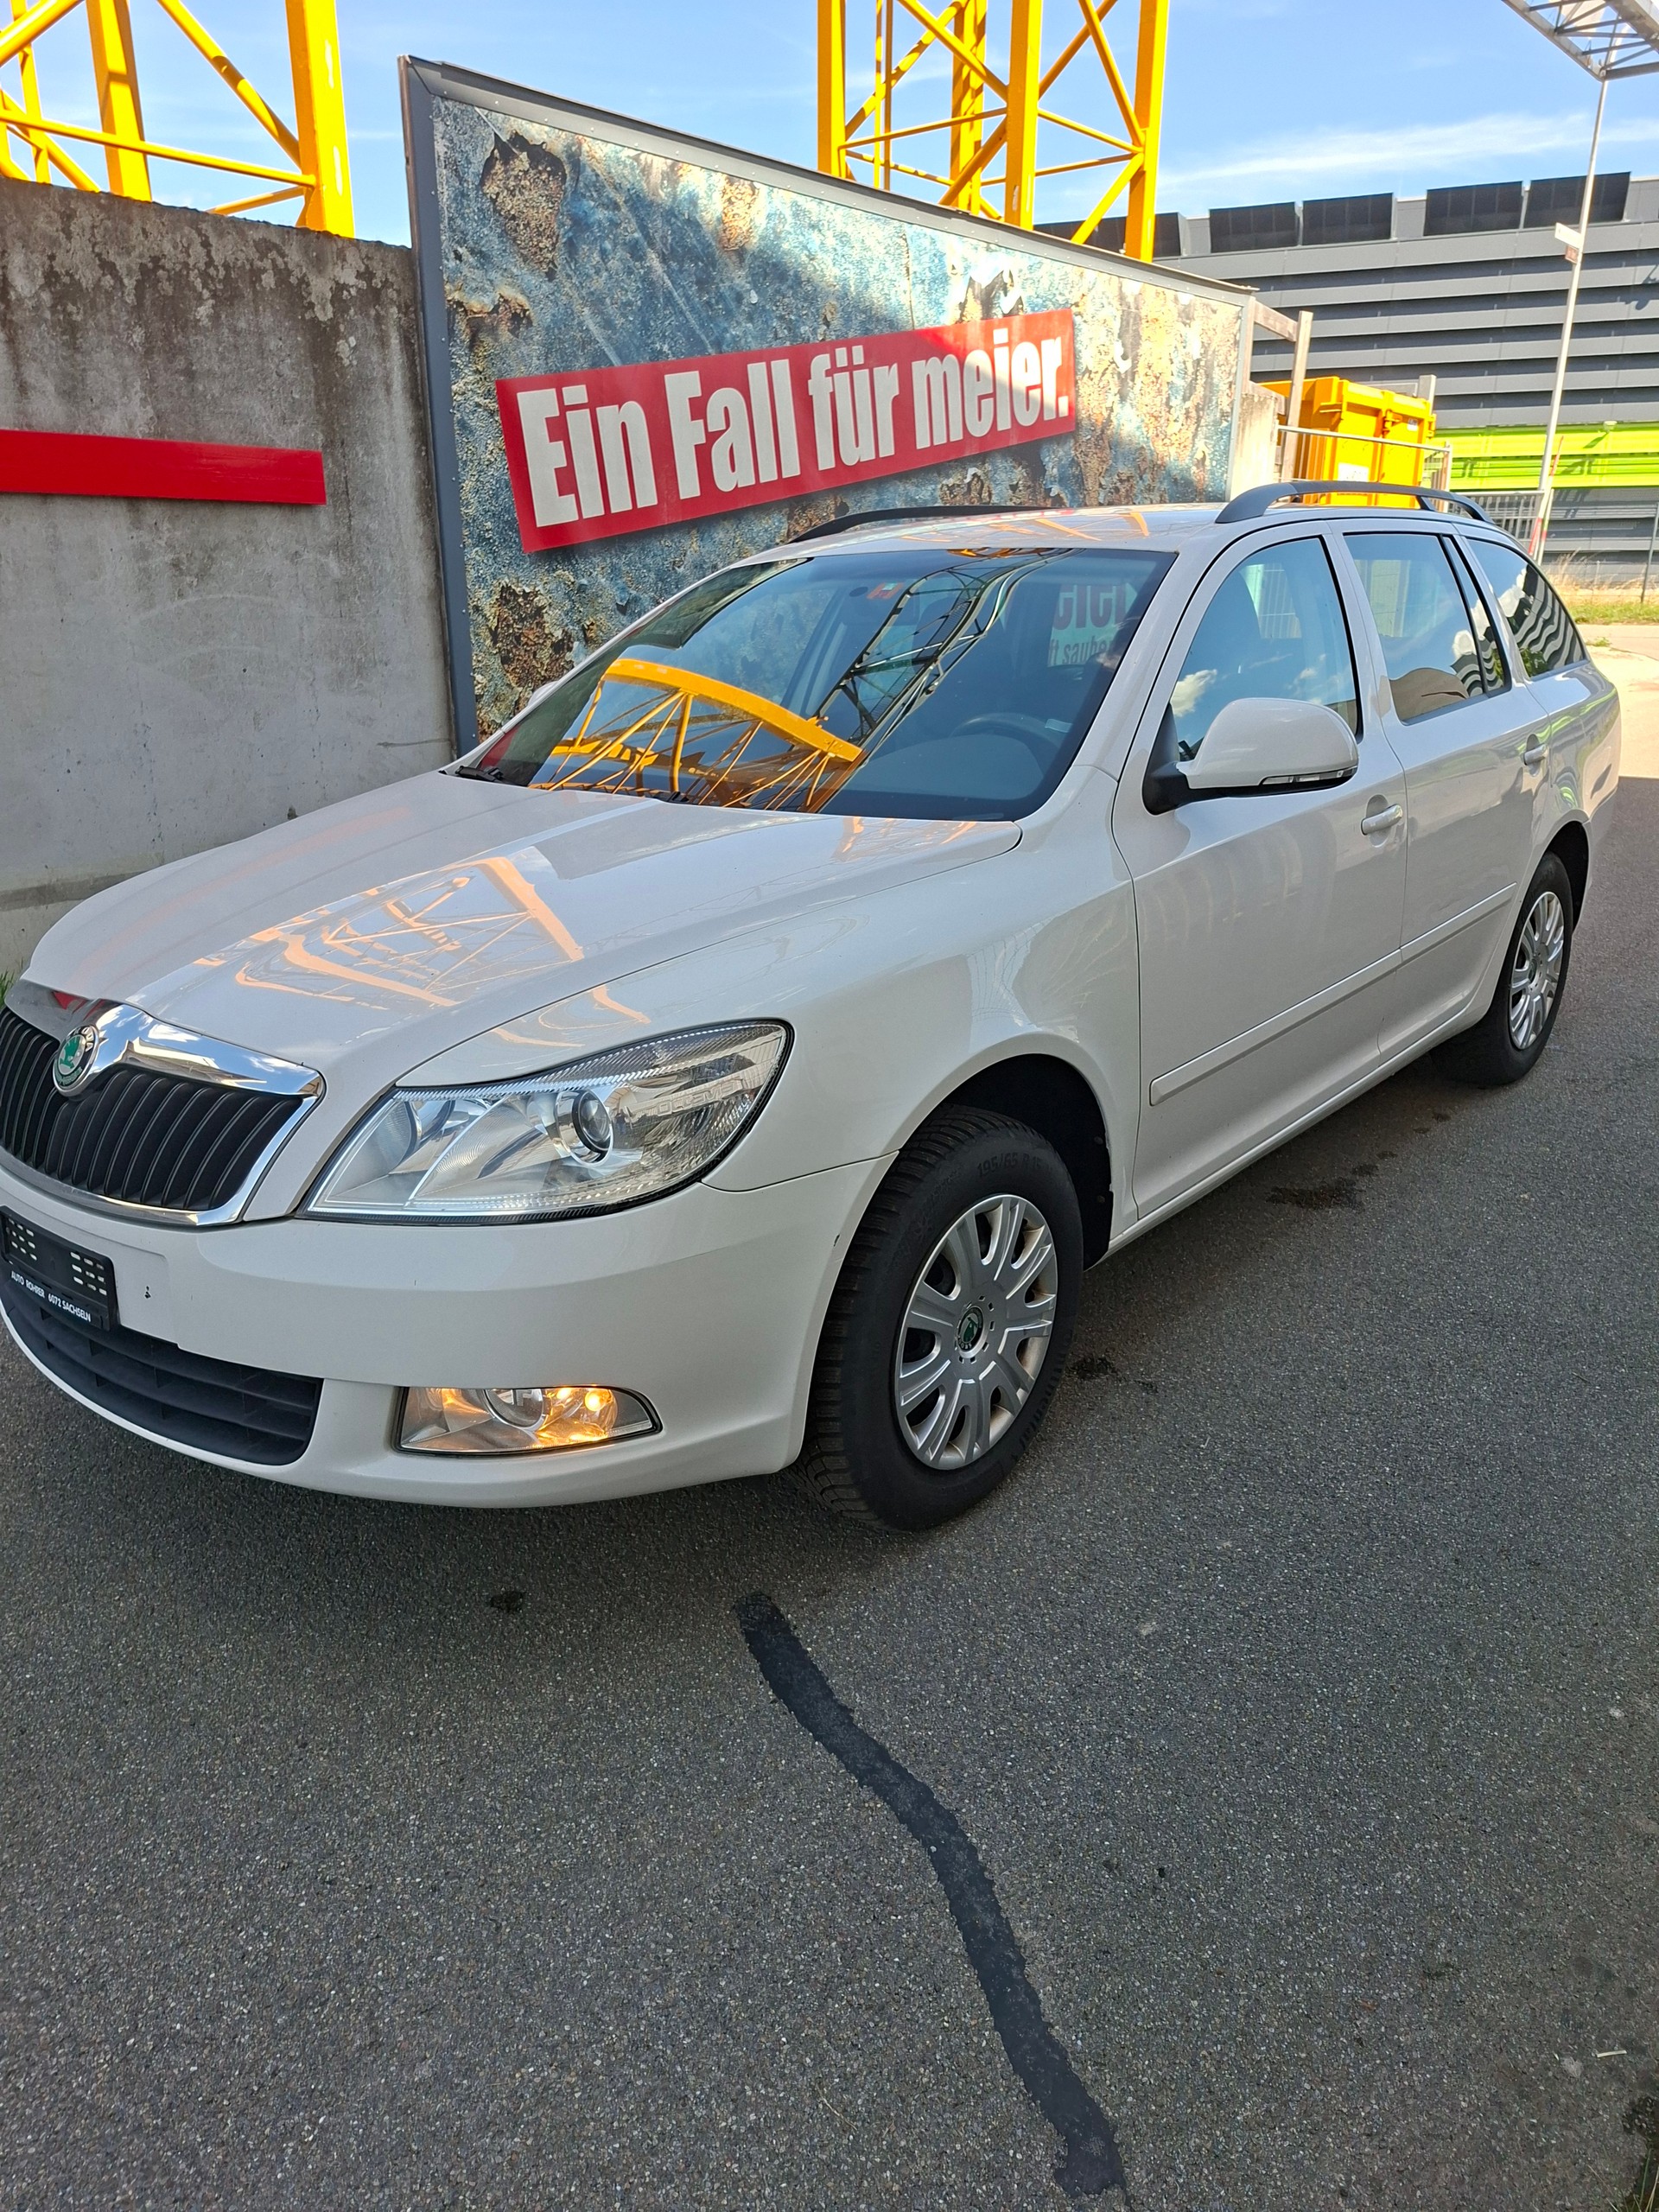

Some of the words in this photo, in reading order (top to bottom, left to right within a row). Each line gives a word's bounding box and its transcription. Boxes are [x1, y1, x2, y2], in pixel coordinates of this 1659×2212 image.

[517, 385, 659, 528] Ein
[664, 359, 801, 499] Fall
[808, 346, 899, 471] für
[911, 328, 1069, 450] meier.
[11, 1270, 24, 1286] AUTO
[48, 1293, 61, 1308] 6072
[61, 1300, 92, 1323] SACHSELN
